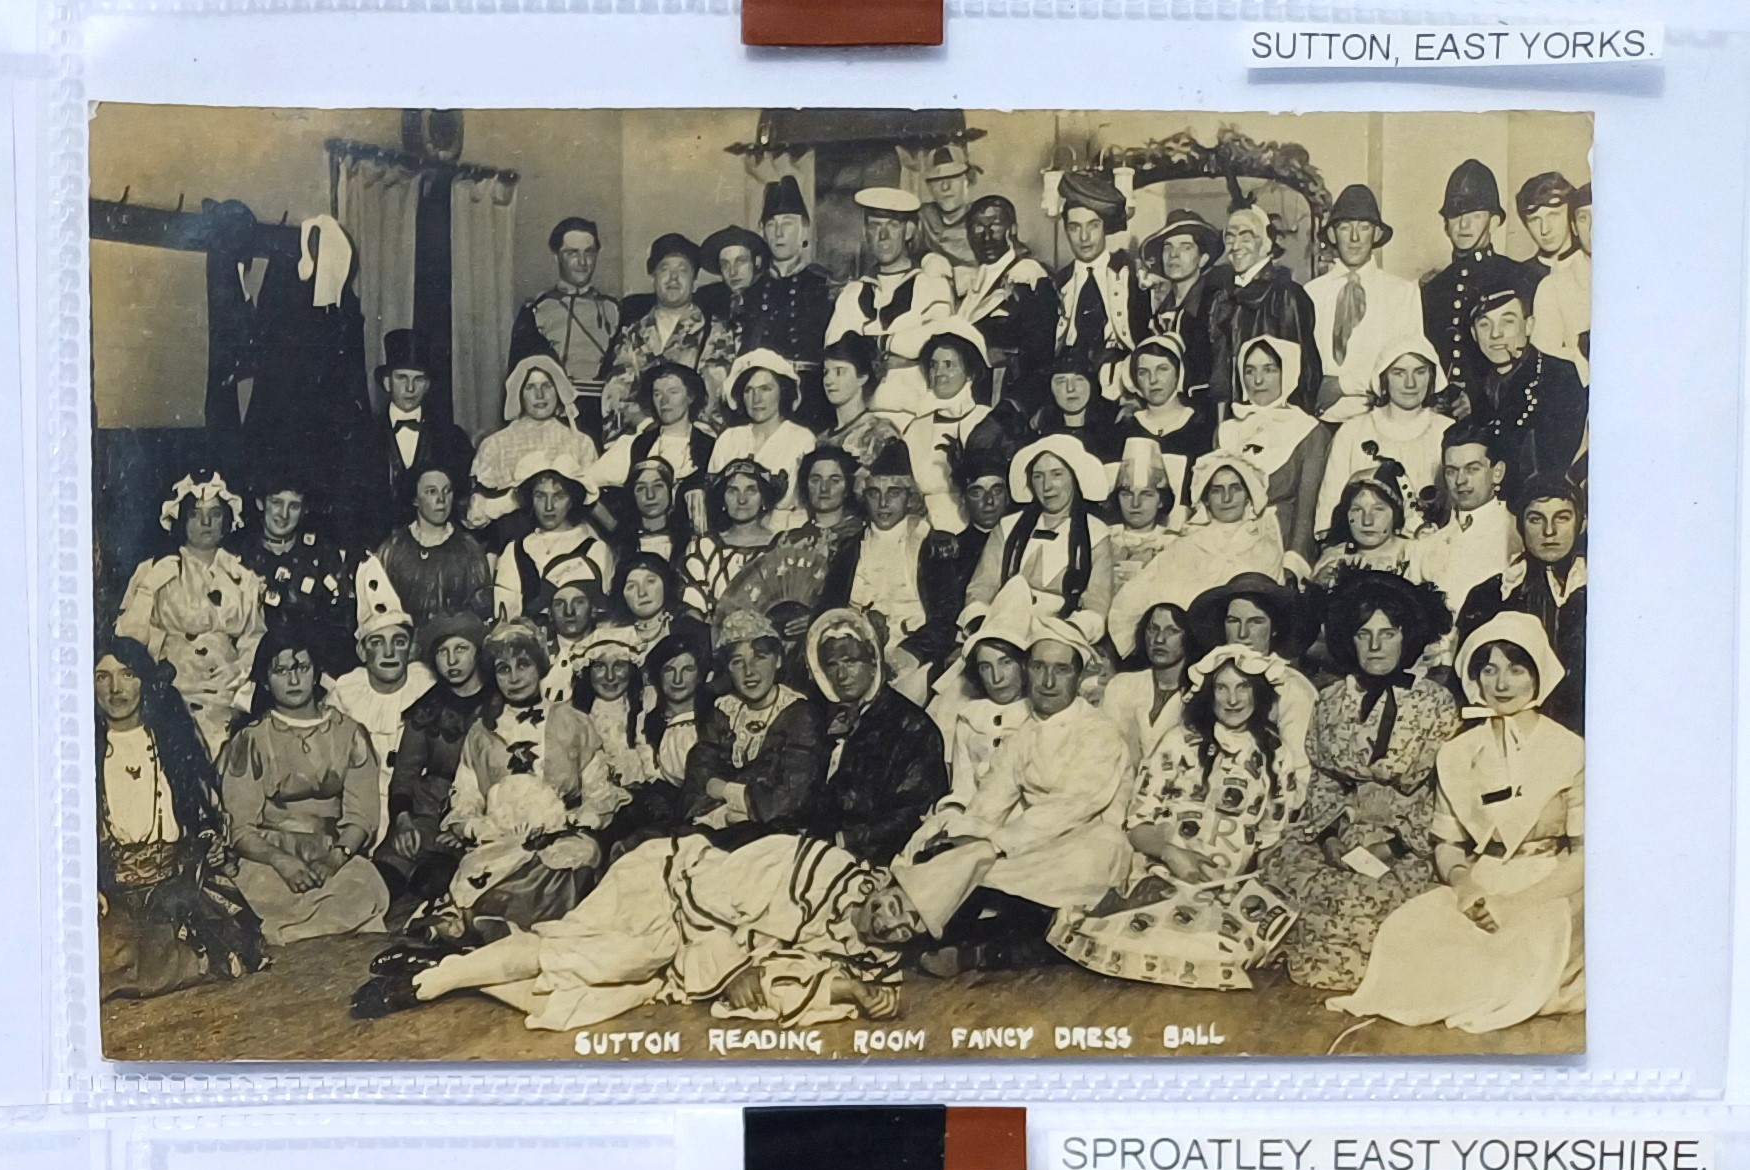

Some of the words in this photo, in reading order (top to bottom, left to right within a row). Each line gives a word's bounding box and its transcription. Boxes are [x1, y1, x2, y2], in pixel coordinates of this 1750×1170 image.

[1251, 31, 1400, 66] SUTTON,
[1414, 32, 1510, 61] EAST
[1520, 29, 1654, 59] YORKS.
[574, 1031, 681, 1055] SUTTON
[708, 1029, 823, 1056] READING
[854, 1029, 926, 1054] ROOM
[951, 1026, 1035, 1050] FANCY
[1054, 1026, 1133, 1050] DRESS
[1163, 1022, 1226, 1048] BALL
